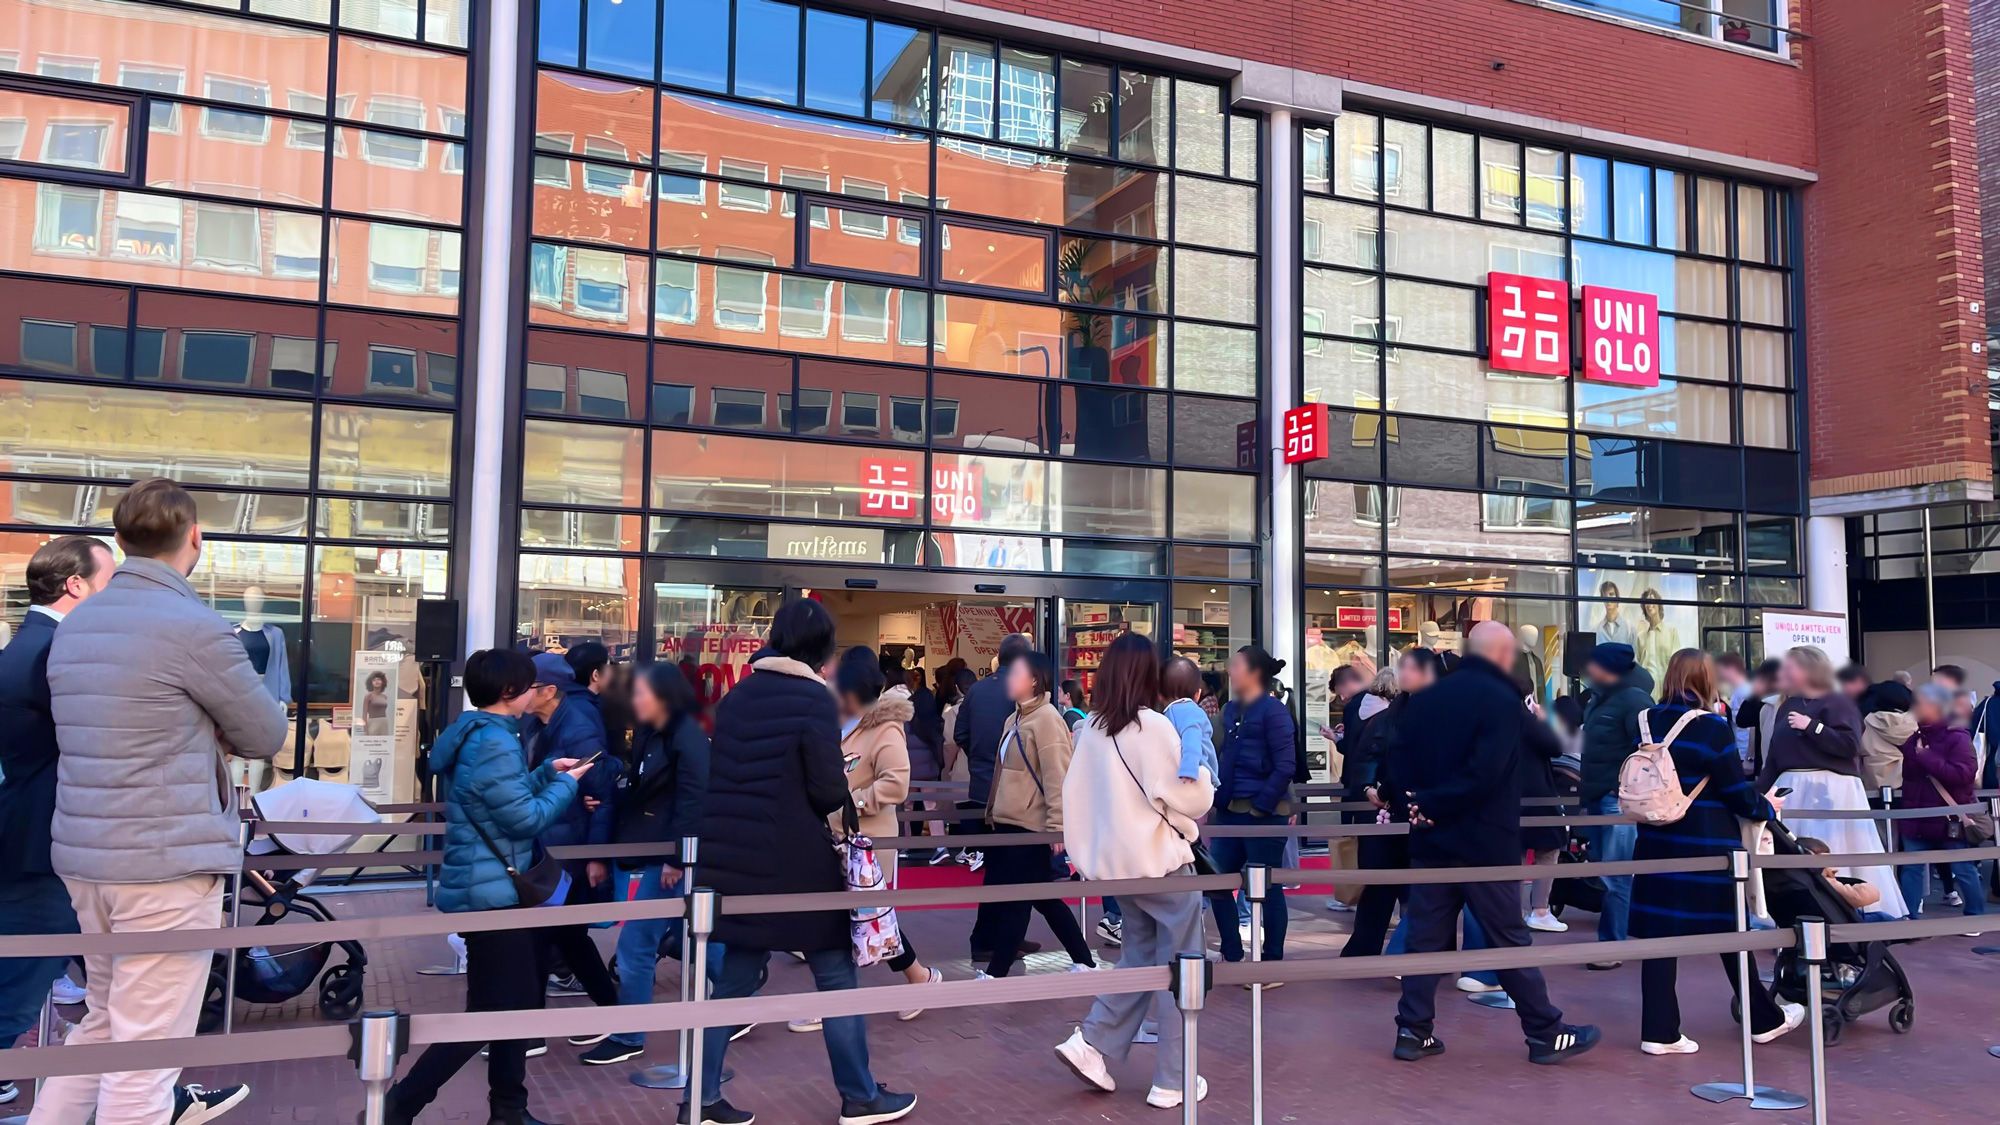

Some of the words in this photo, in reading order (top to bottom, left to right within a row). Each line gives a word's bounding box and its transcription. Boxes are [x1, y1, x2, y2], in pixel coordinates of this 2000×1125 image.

[1593, 298, 1645, 336] UNI
[1594, 338, 1651, 375] QLO
[935, 469, 974, 492] UNI
[935, 493, 976, 517] QLO
[959, 606, 998, 617] OPENING
[1774, 622, 1799, 632] UNIQLO
[1800, 624, 1842, 634] AMSTELVEEN
[1792, 634, 1810, 643] OPEN
[1812, 635, 1826, 644] NOW
